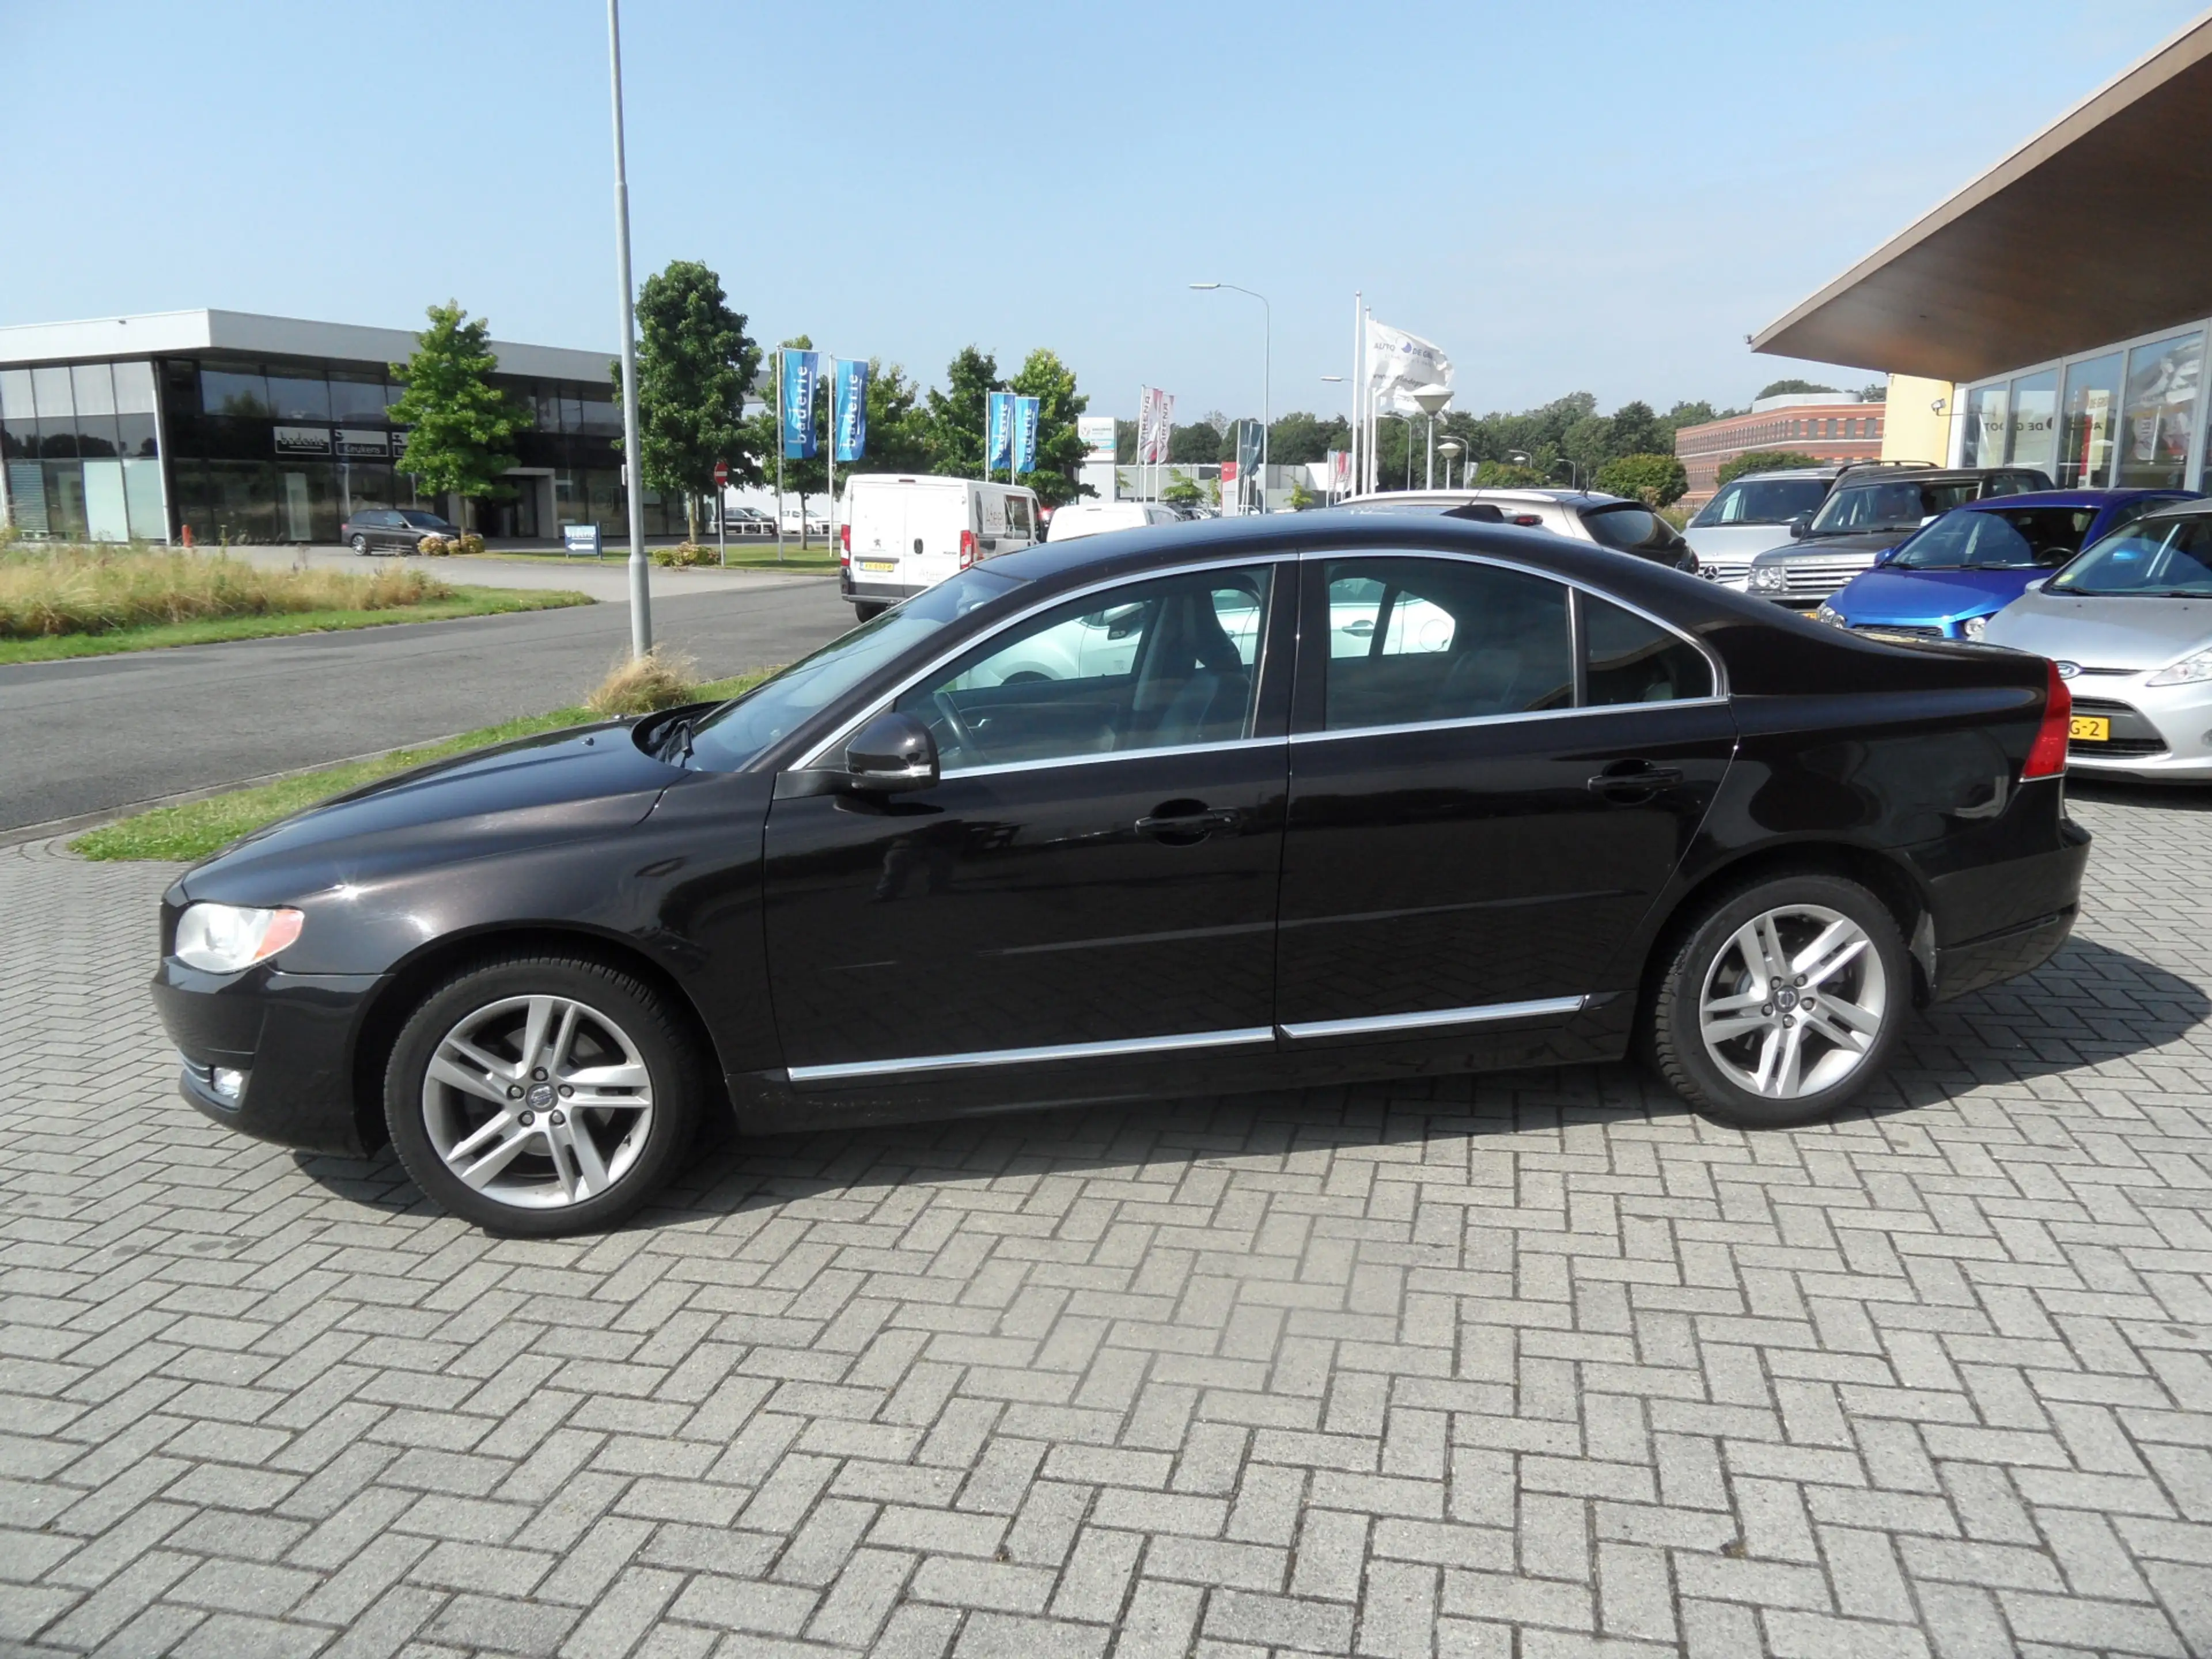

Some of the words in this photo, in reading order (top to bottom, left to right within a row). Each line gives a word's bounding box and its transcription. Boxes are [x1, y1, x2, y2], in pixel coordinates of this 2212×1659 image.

[281, 431, 324, 445] baderie
[788, 366, 808, 444] baderie
[839, 374, 858, 447] baderie
